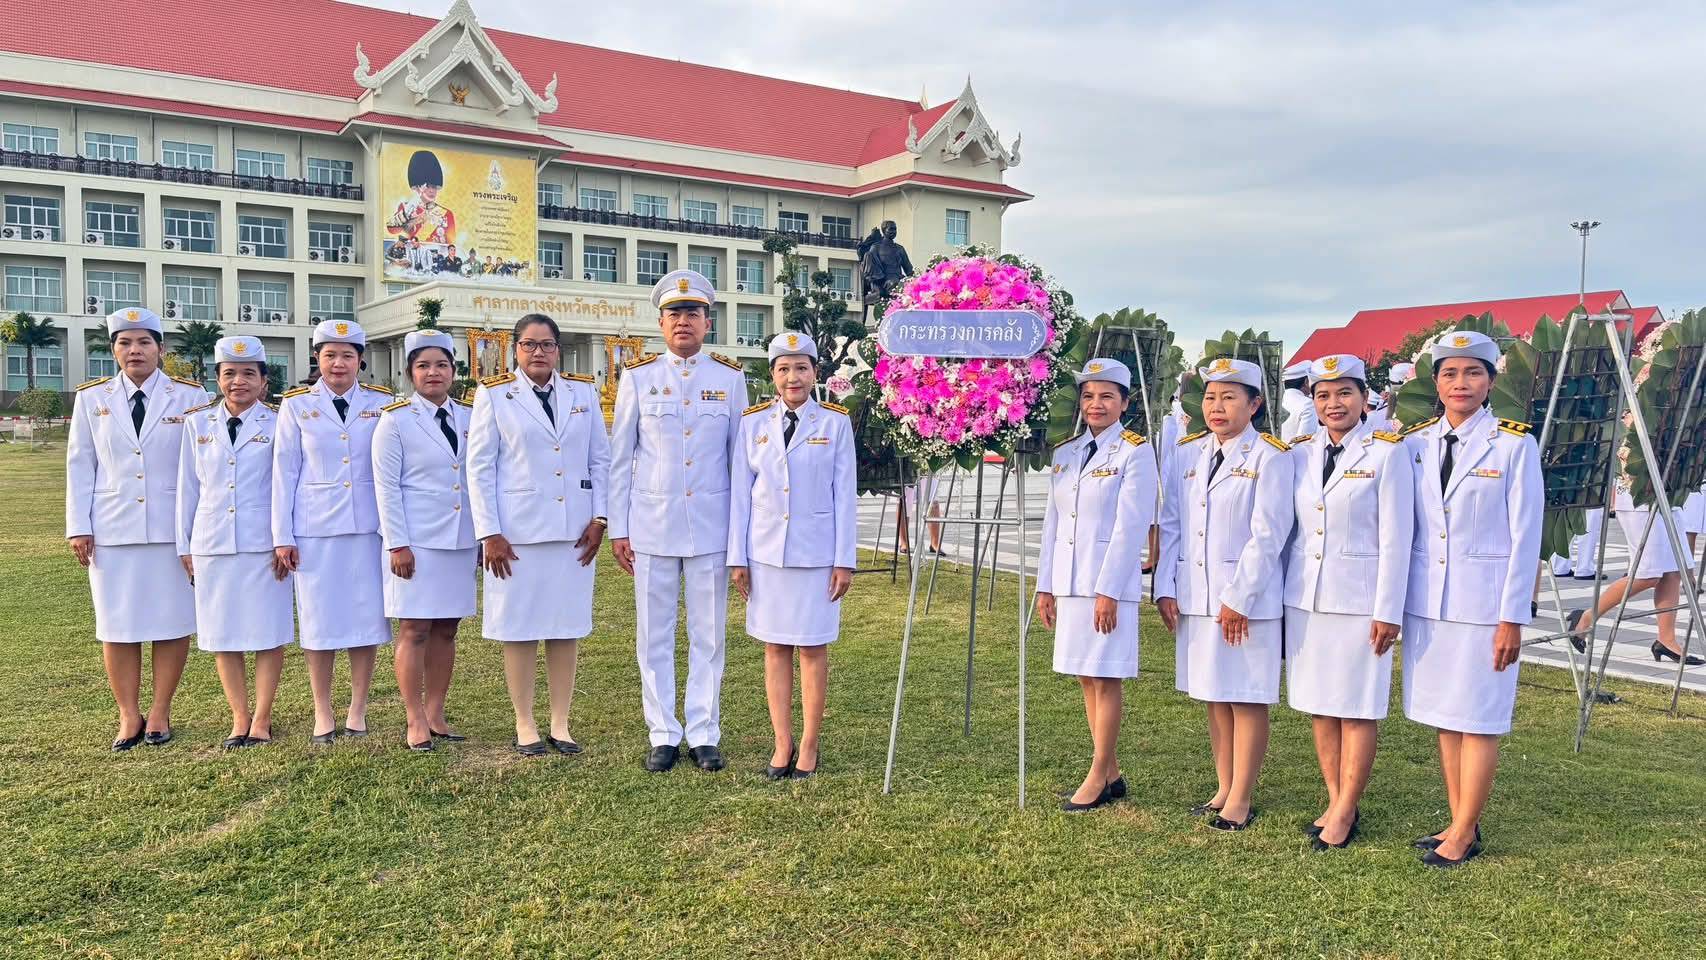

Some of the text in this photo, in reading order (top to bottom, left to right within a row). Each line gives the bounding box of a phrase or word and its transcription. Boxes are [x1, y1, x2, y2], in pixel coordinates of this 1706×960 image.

[473, 191, 518, 203] ทรงพระเจริญ
[473, 295, 635, 319] ศาลากลางจังหวัดสุรินทร์
[899, 319, 1023, 342] กระทรวงการคลัง
